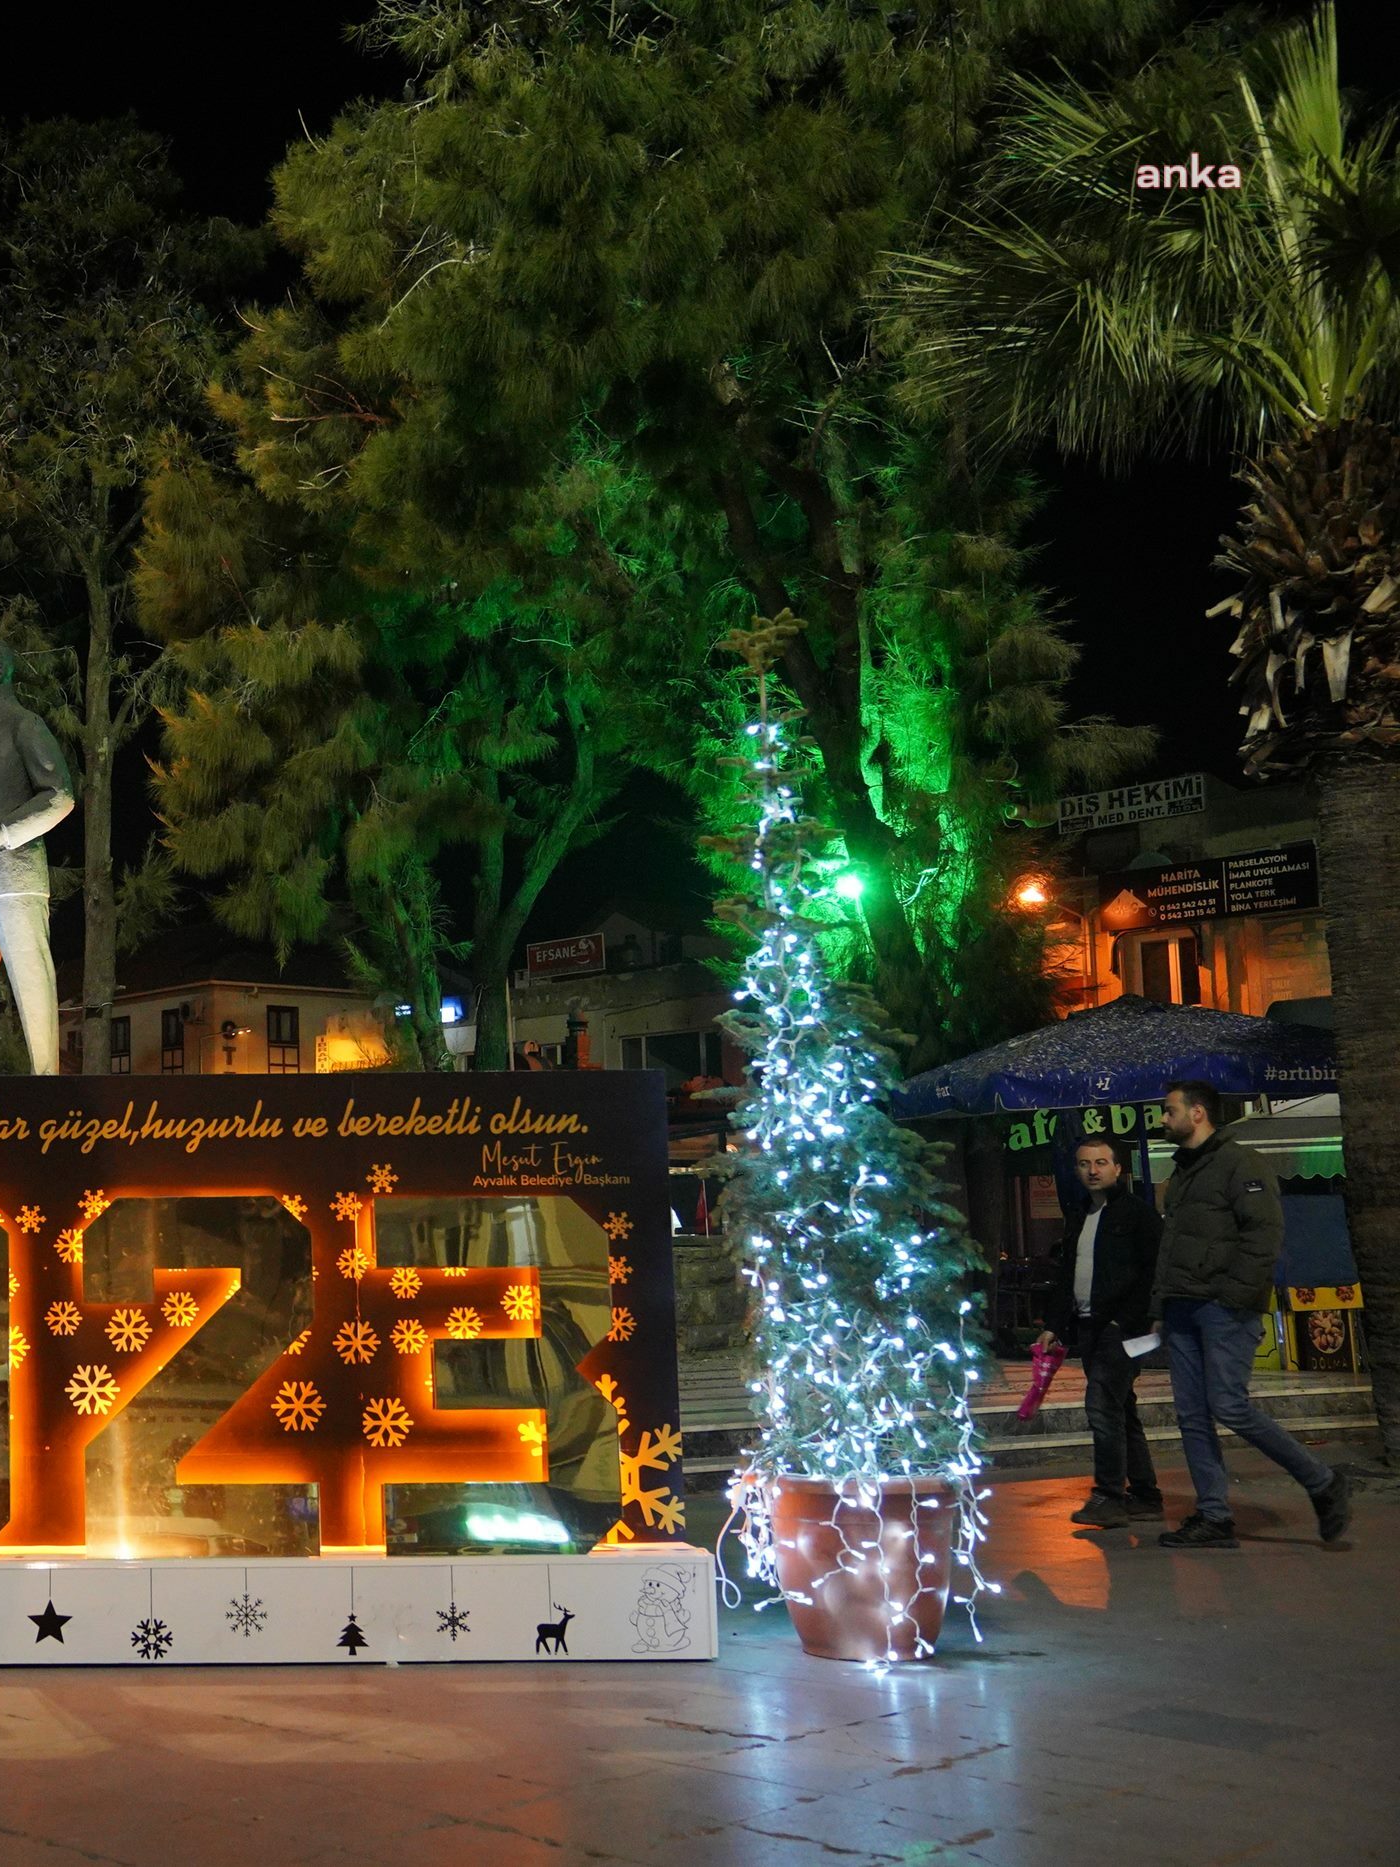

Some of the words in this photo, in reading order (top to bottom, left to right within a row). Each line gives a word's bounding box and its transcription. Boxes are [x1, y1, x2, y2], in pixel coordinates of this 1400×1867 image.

[1097, 814, 1125, 826] MED
[1228, 854, 1288, 869] PARSELASYON
[1161, 868, 1201, 883] HARİTA
[1147, 878, 1220, 898] MÜHENDİSLİK
[1229, 878, 1273, 890] PLANKOTE
[1230, 893, 1253, 901] YOLA
[1254, 889, 1276, 898] TERK
[536, 945, 577, 963] EFSANE
[292, 1116, 329, 1138] ve
[337, 1096, 482, 1137] bereketli
[489, 1095, 589, 1135] olsun.
[1082, 1107, 1107, 1135] &
[481, 1140, 544, 1174] Mesut
[550, 1141, 603, 1184] Ergin
[473, 1175, 518, 1189] Ayvalık
[520, 1174, 573, 1188] Belediye
[583, 1173, 631, 1188] Başkanı
